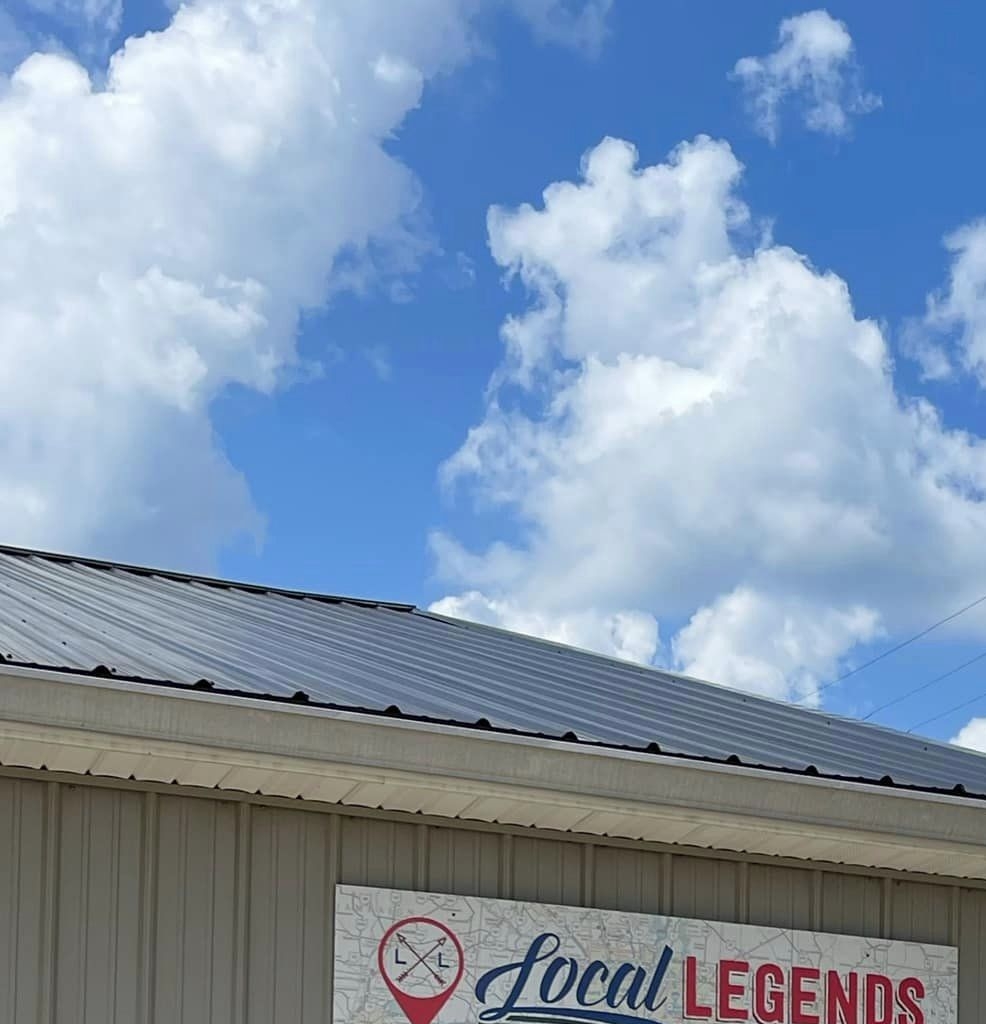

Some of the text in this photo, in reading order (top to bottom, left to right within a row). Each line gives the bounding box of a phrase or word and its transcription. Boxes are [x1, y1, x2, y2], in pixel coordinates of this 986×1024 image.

[395, 948, 450, 969] L L
[475, 932, 674, 1023] Local
